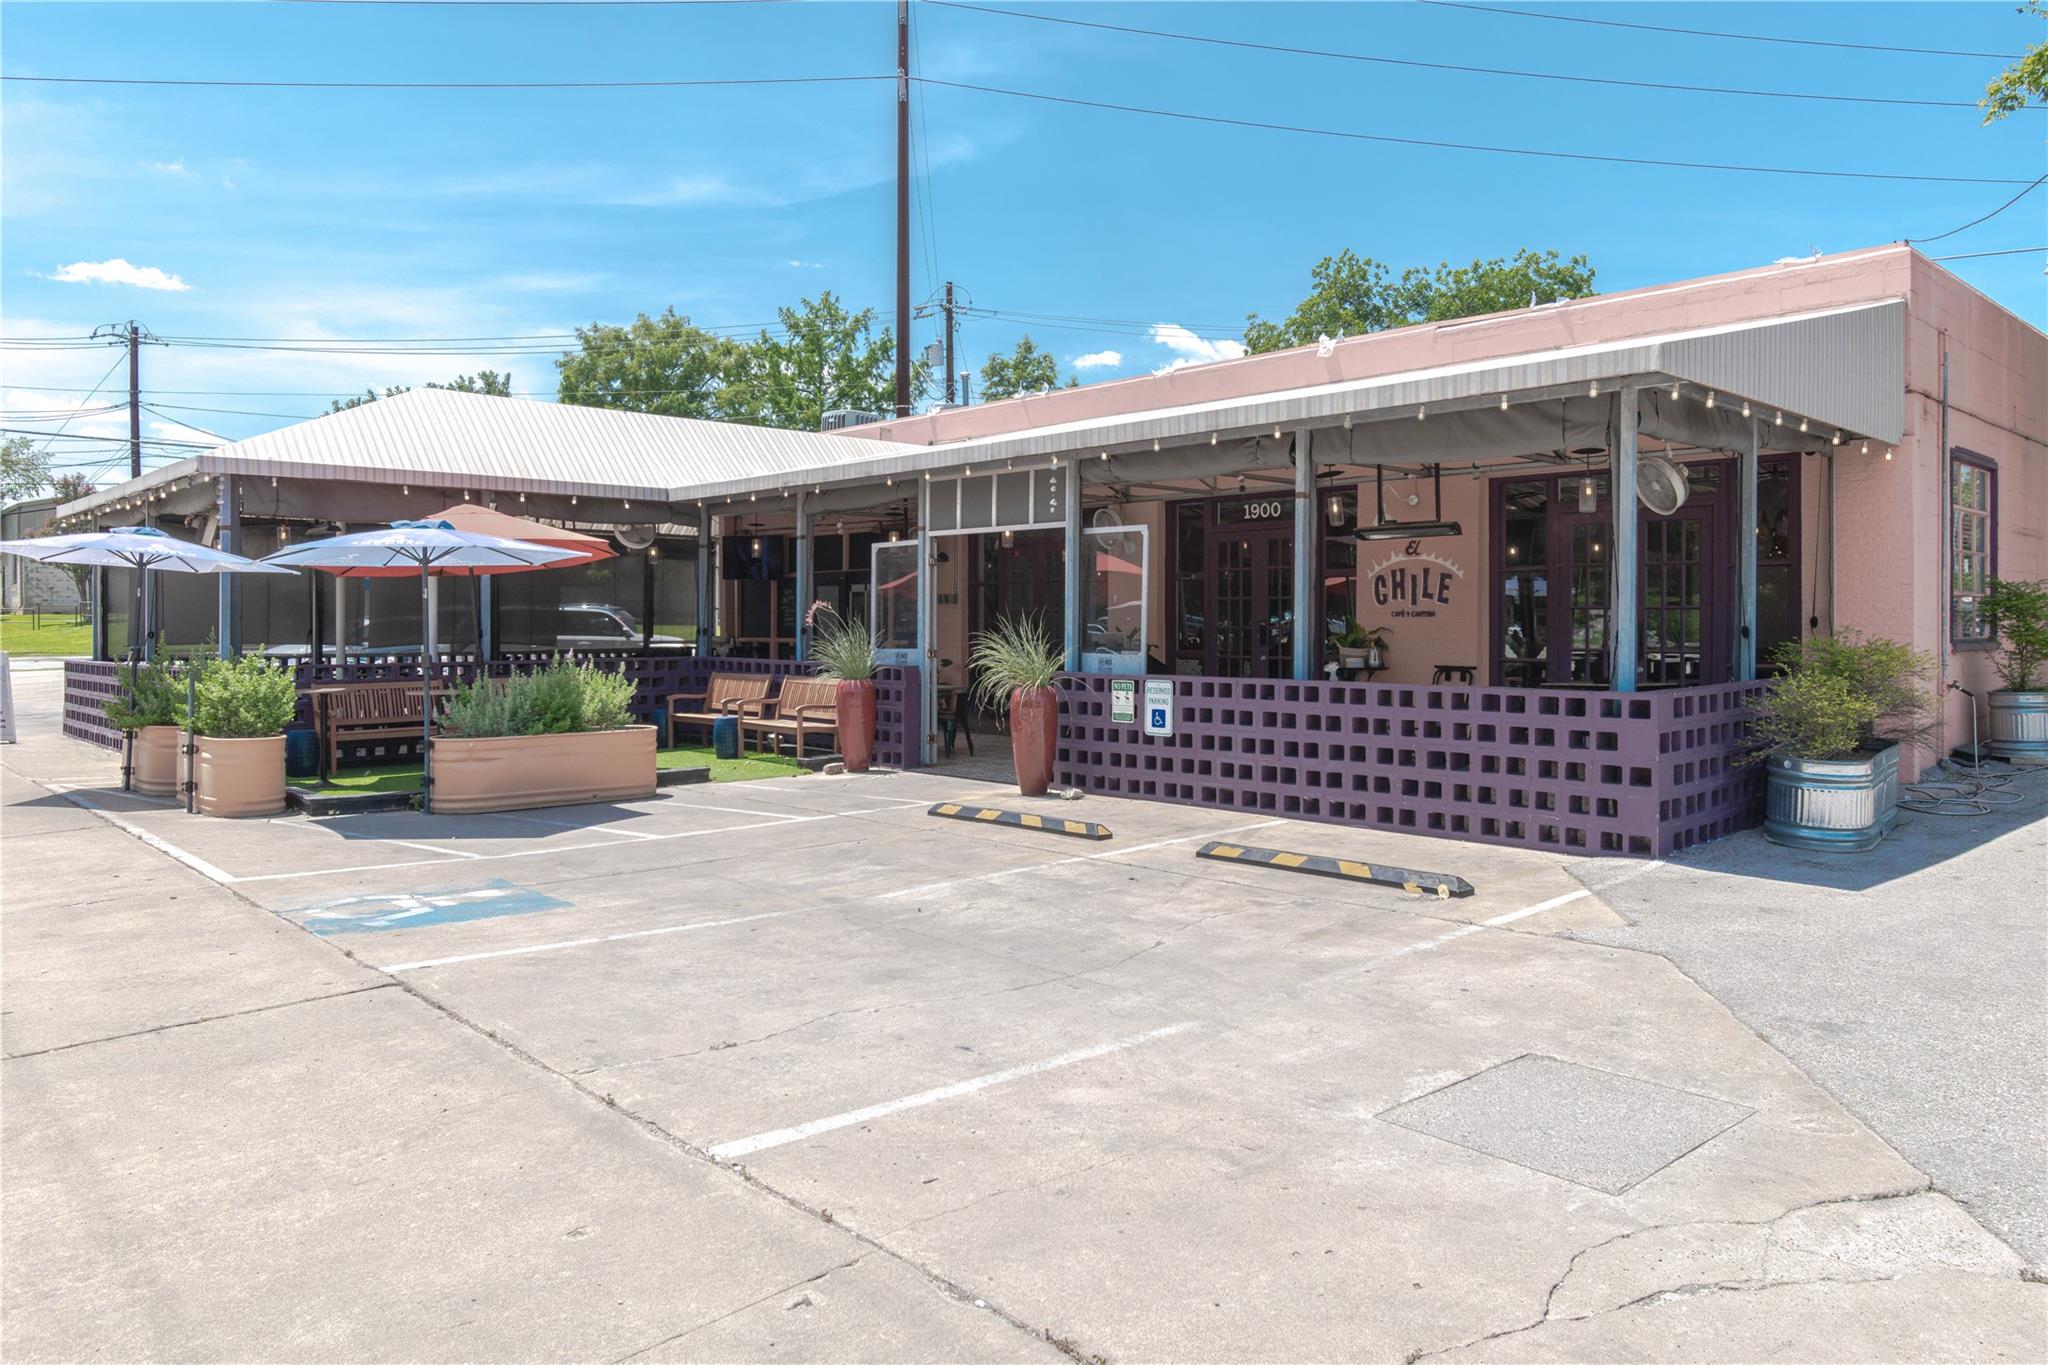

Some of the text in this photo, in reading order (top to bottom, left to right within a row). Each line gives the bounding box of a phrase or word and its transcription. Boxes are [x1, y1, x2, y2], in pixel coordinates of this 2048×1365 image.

[1243, 501, 1281, 519] 1900
[1373, 567, 1453, 607] CHILE
[1147, 686, 1171, 695] RESERVED
[1148, 697, 1169, 706] PARKING
